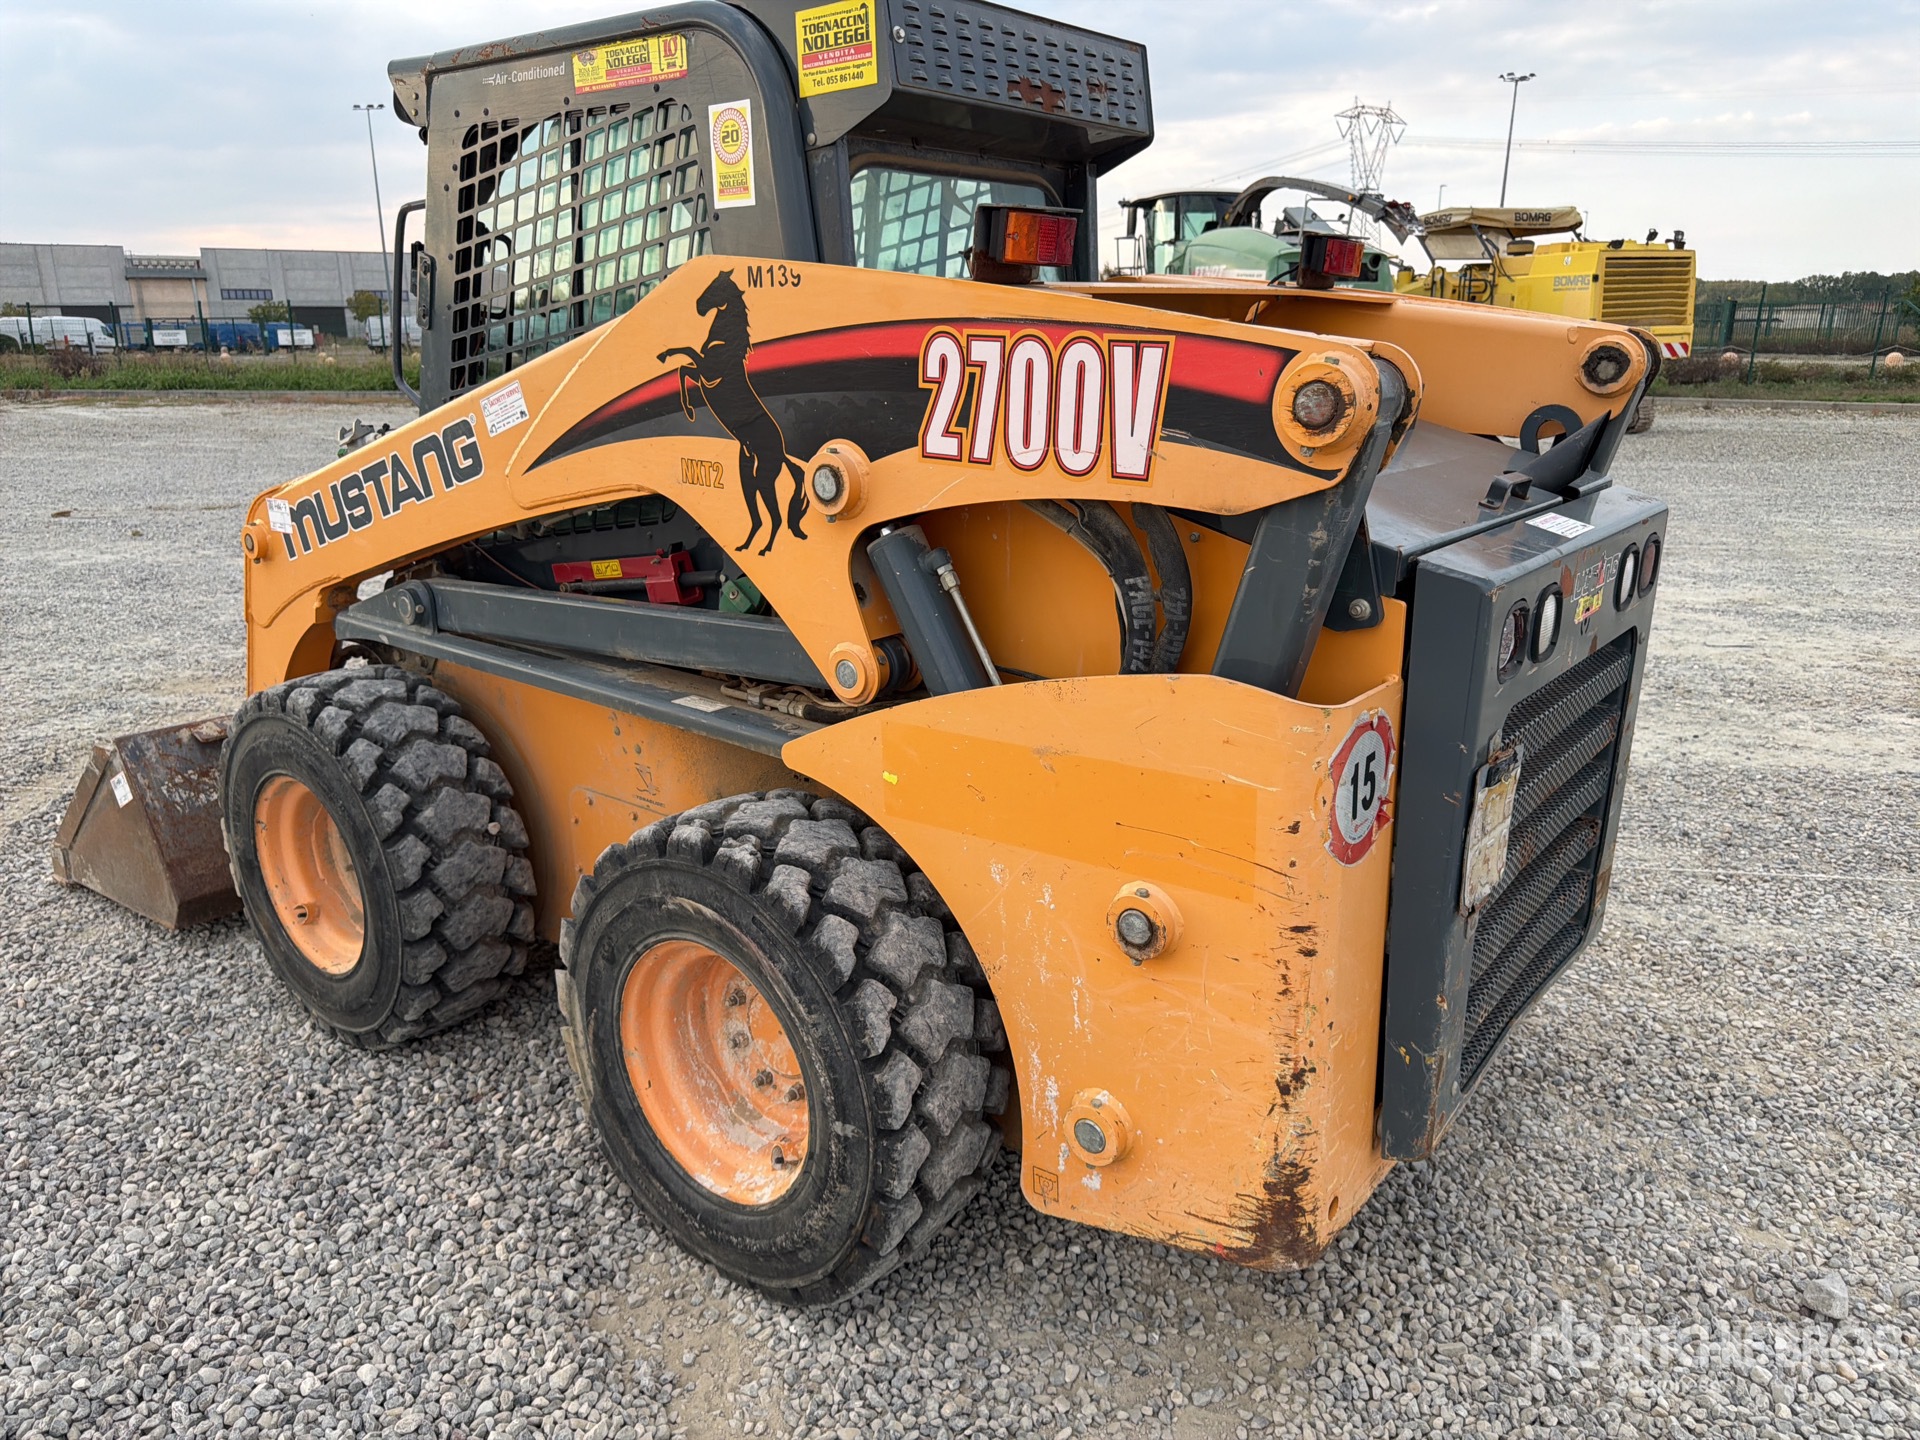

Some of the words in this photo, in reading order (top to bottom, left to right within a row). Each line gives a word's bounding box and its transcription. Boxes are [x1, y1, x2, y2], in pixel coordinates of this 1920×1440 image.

[817, 48, 855, 60] VENDITA
[495, 61, 565, 85] Air-Conditioned
[812, 78, 825, 88] Tel.
[827, 75, 839, 85] 055
[840, 70, 864, 83] 861440
[721, 129, 740, 144] 20
[1423, 213, 1453, 226] BOMAG
[1514, 211, 1552, 222] BOMAG
[1553, 275, 1591, 287] BOMAG
[918, 326, 1175, 486] 2700V
[681, 457, 724, 489] NXT2
[281, 417, 485, 561] MUSTANG
[1350, 750, 1376, 821] 15
